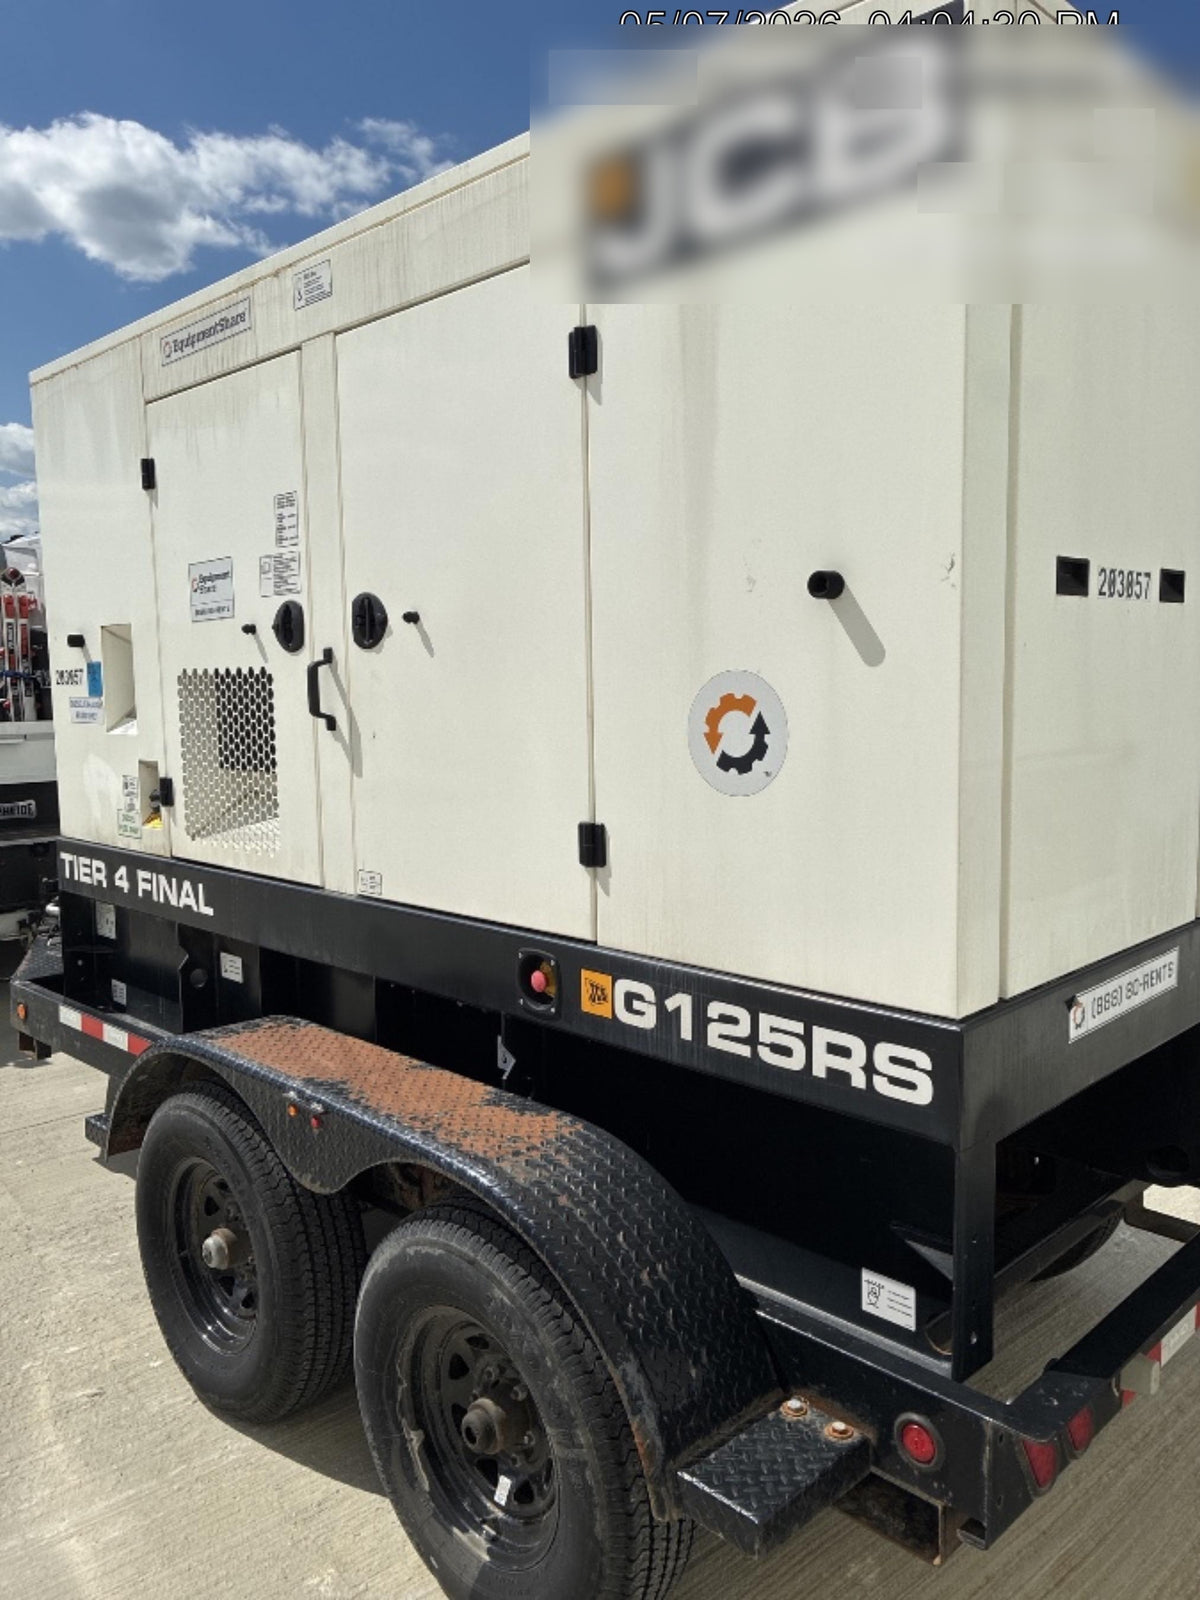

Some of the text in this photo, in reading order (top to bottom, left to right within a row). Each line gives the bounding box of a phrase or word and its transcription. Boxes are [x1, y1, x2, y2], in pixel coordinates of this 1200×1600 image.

[1098, 567, 1151, 600] 203057
[59, 851, 215, 917] TIER 4 FINAL
[614, 978, 934, 1106] G125RS
